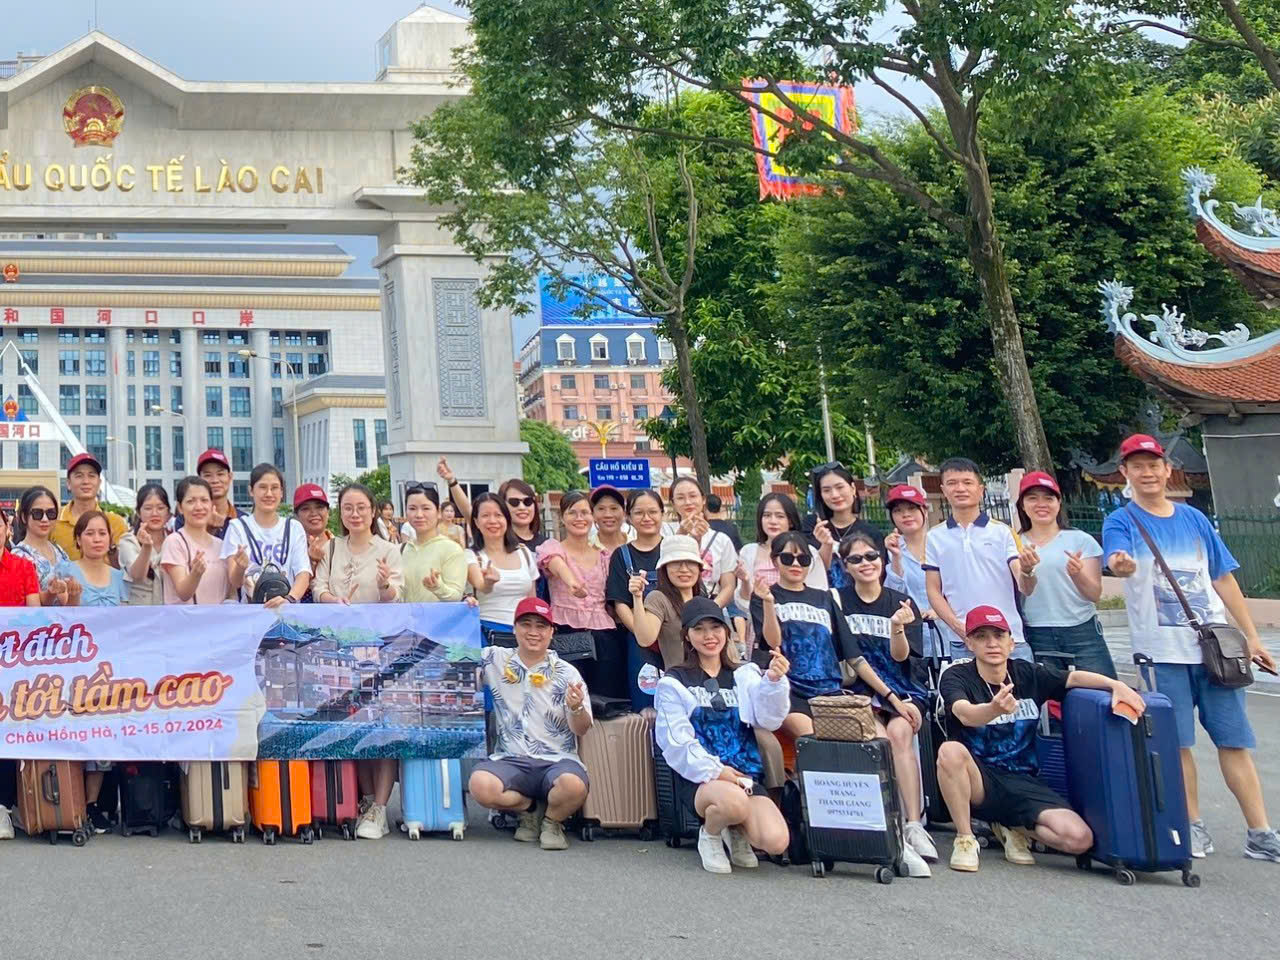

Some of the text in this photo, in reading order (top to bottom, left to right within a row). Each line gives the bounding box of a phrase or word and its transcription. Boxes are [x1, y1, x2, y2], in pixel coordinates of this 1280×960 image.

[44, 153, 136, 192] QUỐC
[146, 154, 186, 192] TẾ
[194, 157, 259, 193] LÀO
[271, 165, 325, 193] CAI
[21, 625, 96, 666] đích
[9, 674, 69, 720] tới
[70, 662, 150, 716] tầm
[153, 671, 232, 709] cao
[6, 719, 223, 744] Châu Hồng Hà, 12-15.07.2024
